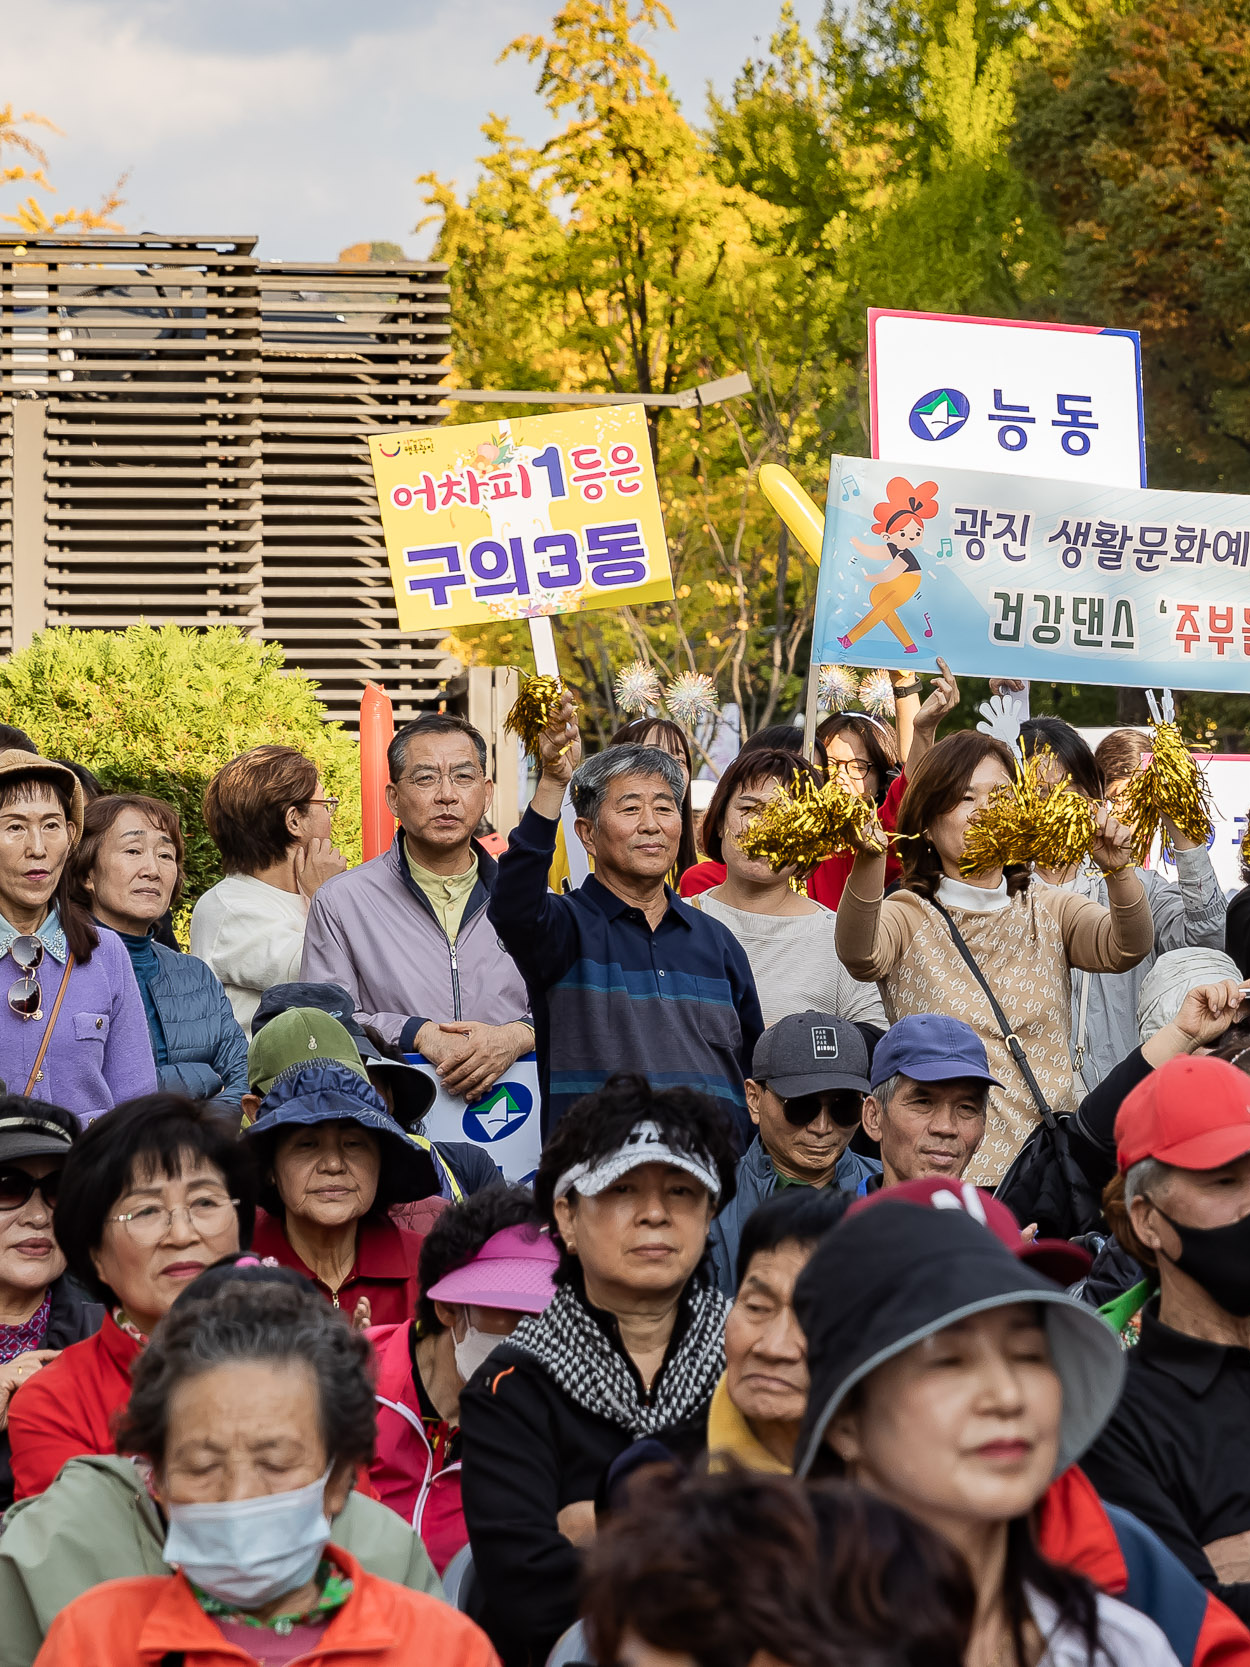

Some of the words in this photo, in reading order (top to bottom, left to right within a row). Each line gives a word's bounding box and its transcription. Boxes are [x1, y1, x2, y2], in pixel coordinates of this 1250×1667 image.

[988, 389, 1099, 456] 능동
[407, 523, 647, 606] 구의3동
[954, 508, 1031, 562] 광진
[994, 592, 1134, 650] 건강댄스
